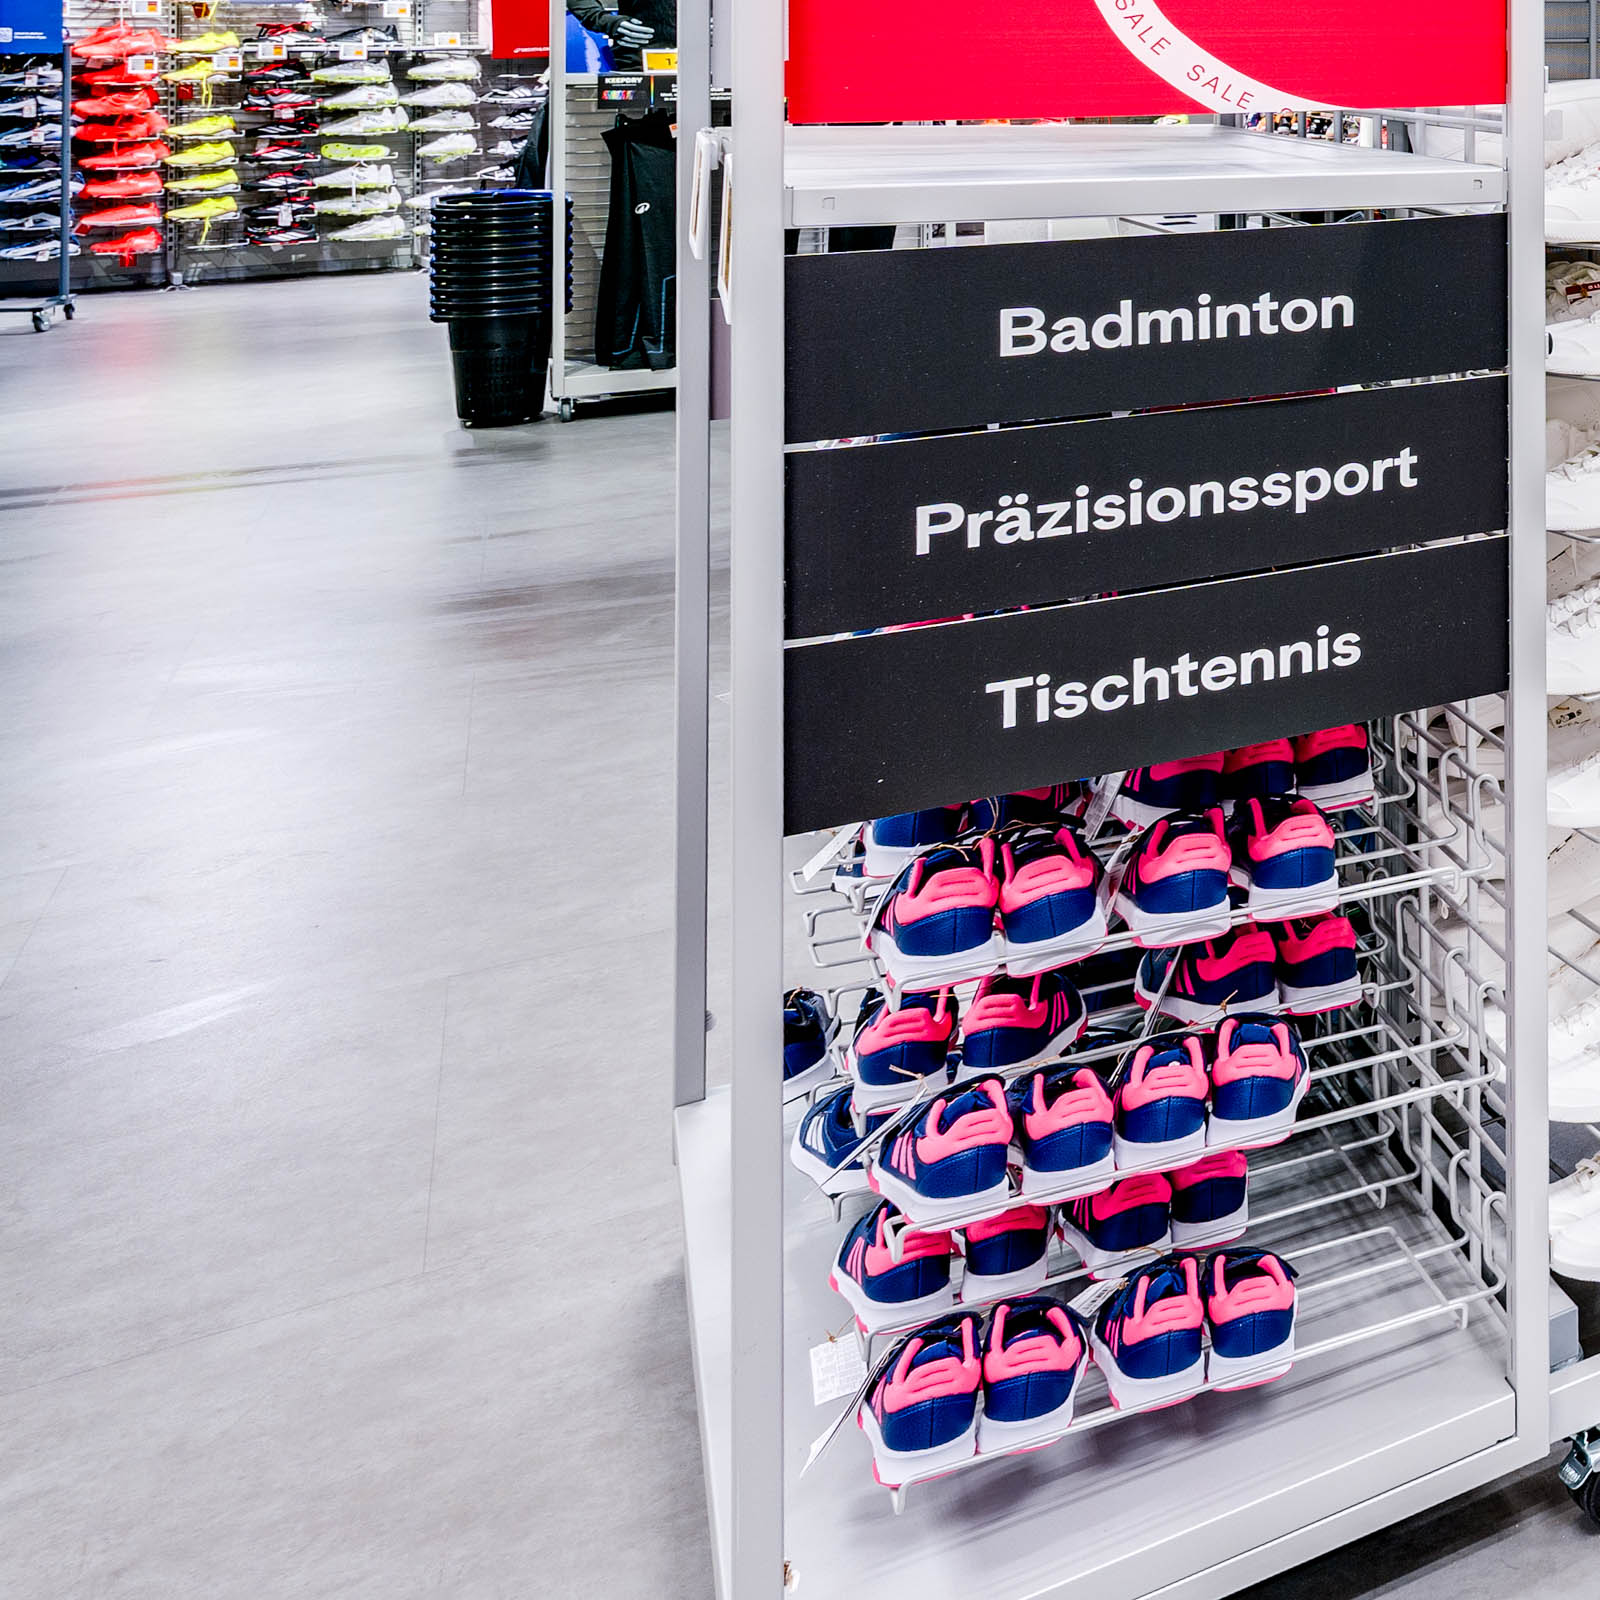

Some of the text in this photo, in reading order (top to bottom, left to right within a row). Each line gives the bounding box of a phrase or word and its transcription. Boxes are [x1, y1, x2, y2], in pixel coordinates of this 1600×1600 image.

[1186, 62, 1256, 112] SALE
[999, 292, 1356, 356] Badminton
[915, 446, 1418, 556] Präzisionssport
[985, 625, 1363, 730] Tischtennis
